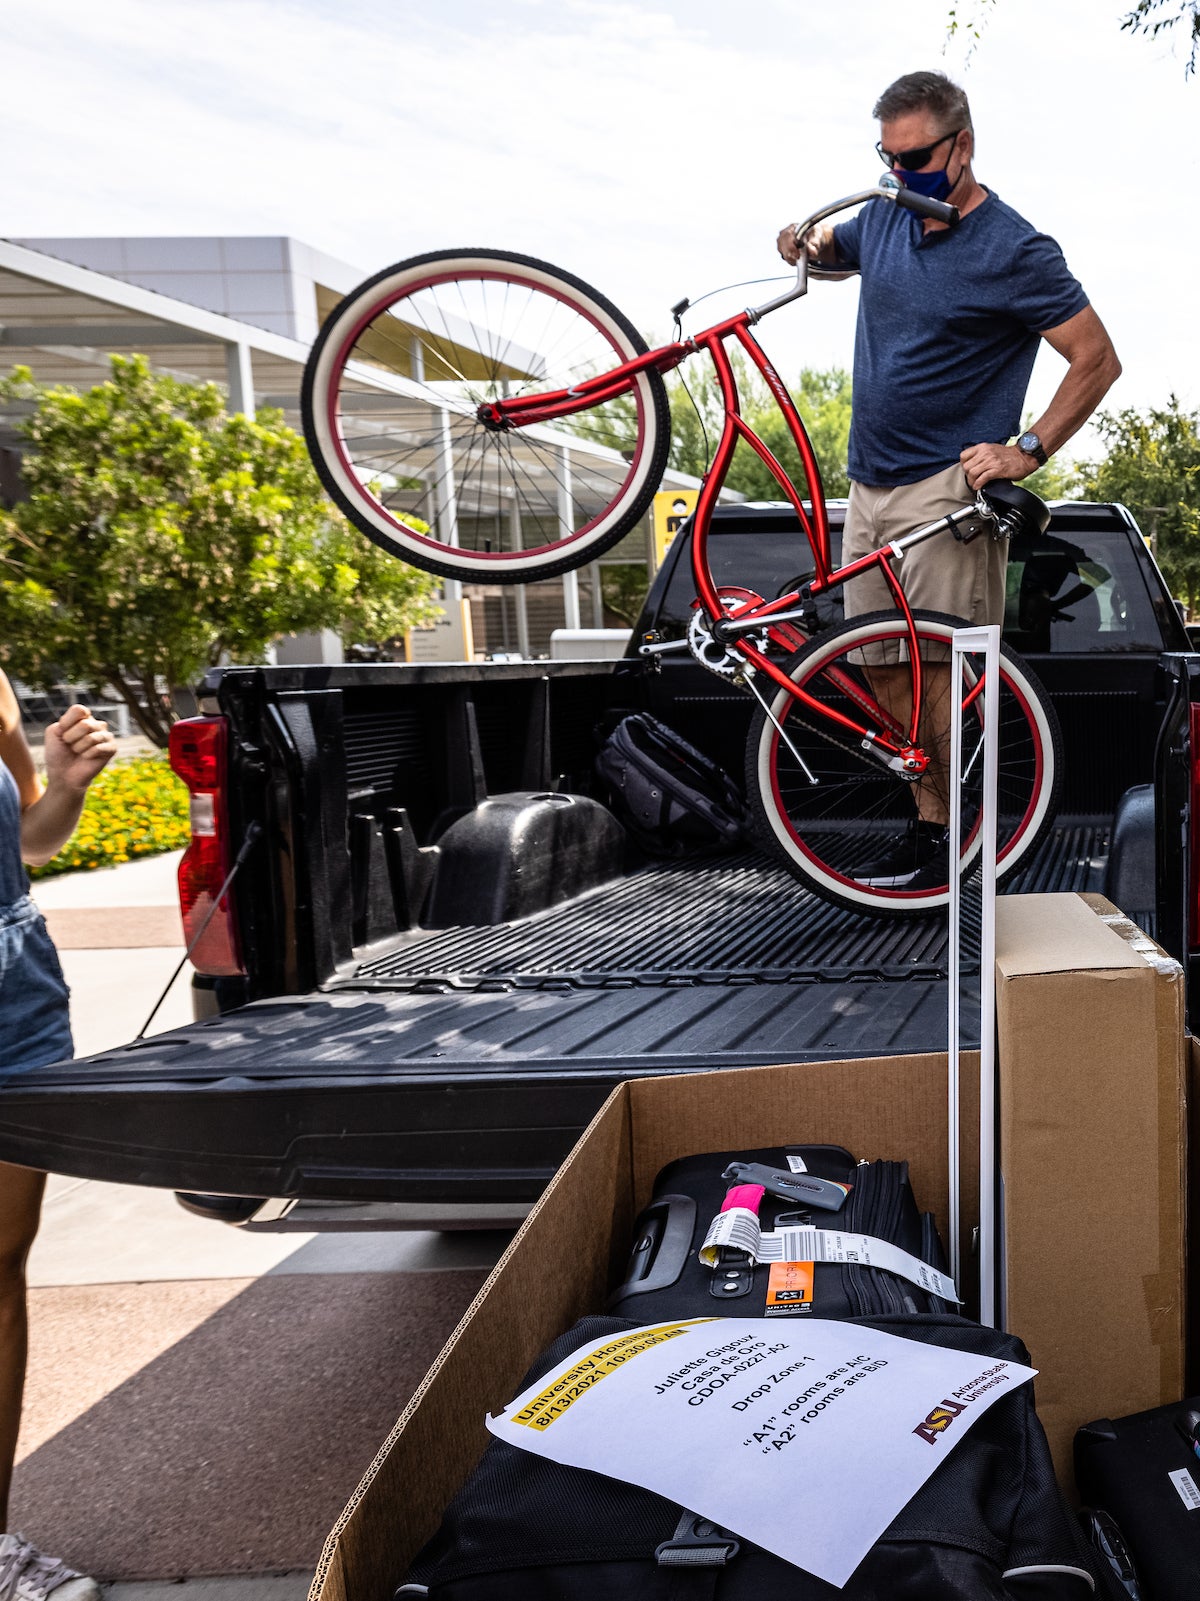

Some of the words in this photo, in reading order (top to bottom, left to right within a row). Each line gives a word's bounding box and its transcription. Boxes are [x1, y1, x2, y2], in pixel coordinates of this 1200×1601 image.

[518, 1360, 595, 1421] University
[594, 1332, 655, 1359] Housing
[535, 1369, 607, 1426] 8/13/2021
[606, 1336, 665, 1368] 10:30:00
[662, 1328, 690, 1339] AM
[654, 1357, 708, 1395] Juliette
[705, 1334, 758, 1358] Gigoux
[681, 1365, 721, 1391] Casa
[720, 1354, 740, 1366] de
[738, 1341, 766, 1356] Oro
[687, 1343, 790, 1407] CDOA-0227-A2
[731, 1383, 771, 1412] Drop
[767, 1361, 806, 1384] Zone
[781, 1381, 827, 1417] rooms
[825, 1366, 849, 1381] are
[845, 1354, 871, 1369] A/C
[800, 1386, 845, 1424] rooms
[843, 1371, 867, 1386] are
[861, 1359, 889, 1373] B/D
[951, 1375, 987, 1399] Arizona
[981, 1362, 1009, 1377] State
[912, 1399, 968, 1446] ASU
[962, 1373, 1010, 1402] University
